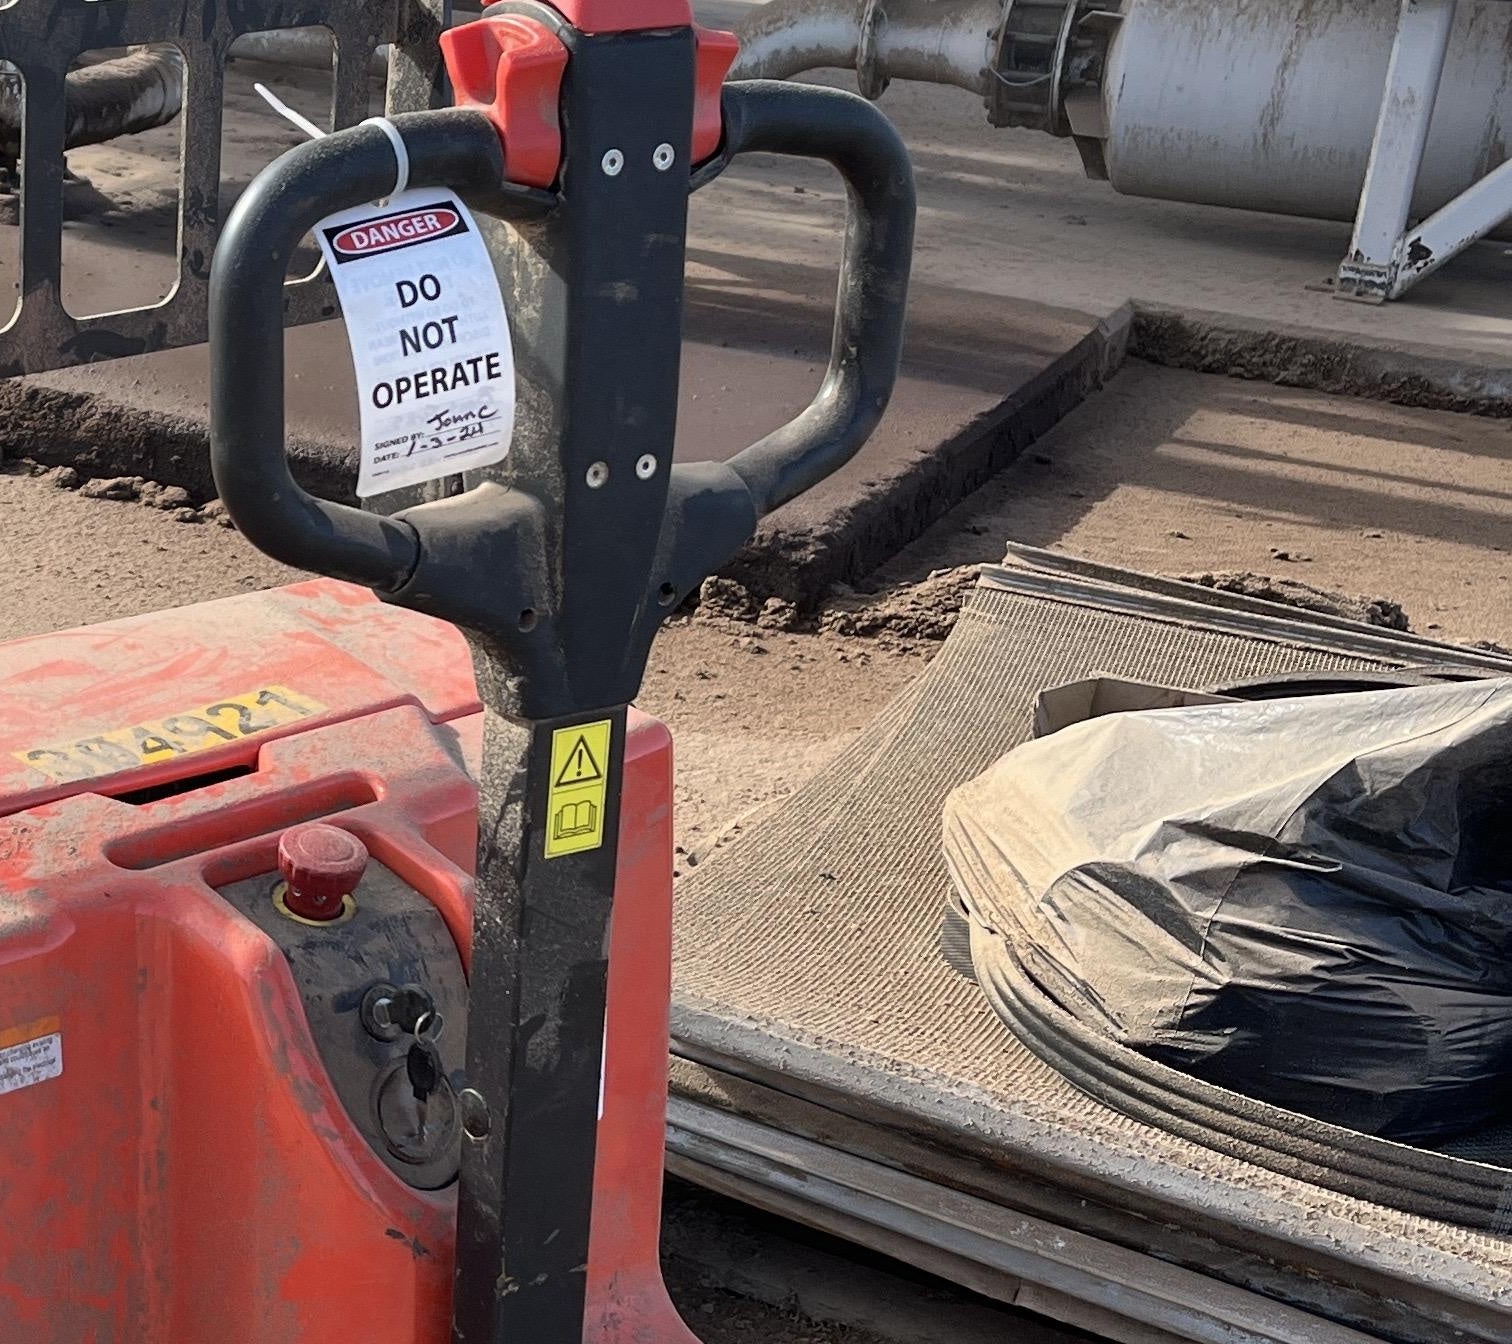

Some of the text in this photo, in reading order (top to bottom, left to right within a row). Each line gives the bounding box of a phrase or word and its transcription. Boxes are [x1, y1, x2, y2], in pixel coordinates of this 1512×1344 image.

[350, 213, 441, 249] DANGER
[395, 273, 442, 309] DO
[398, 314, 459, 357] NOT
[372, 352, 502, 409] OPERATE
[373, 435, 409, 451] SIGNED
